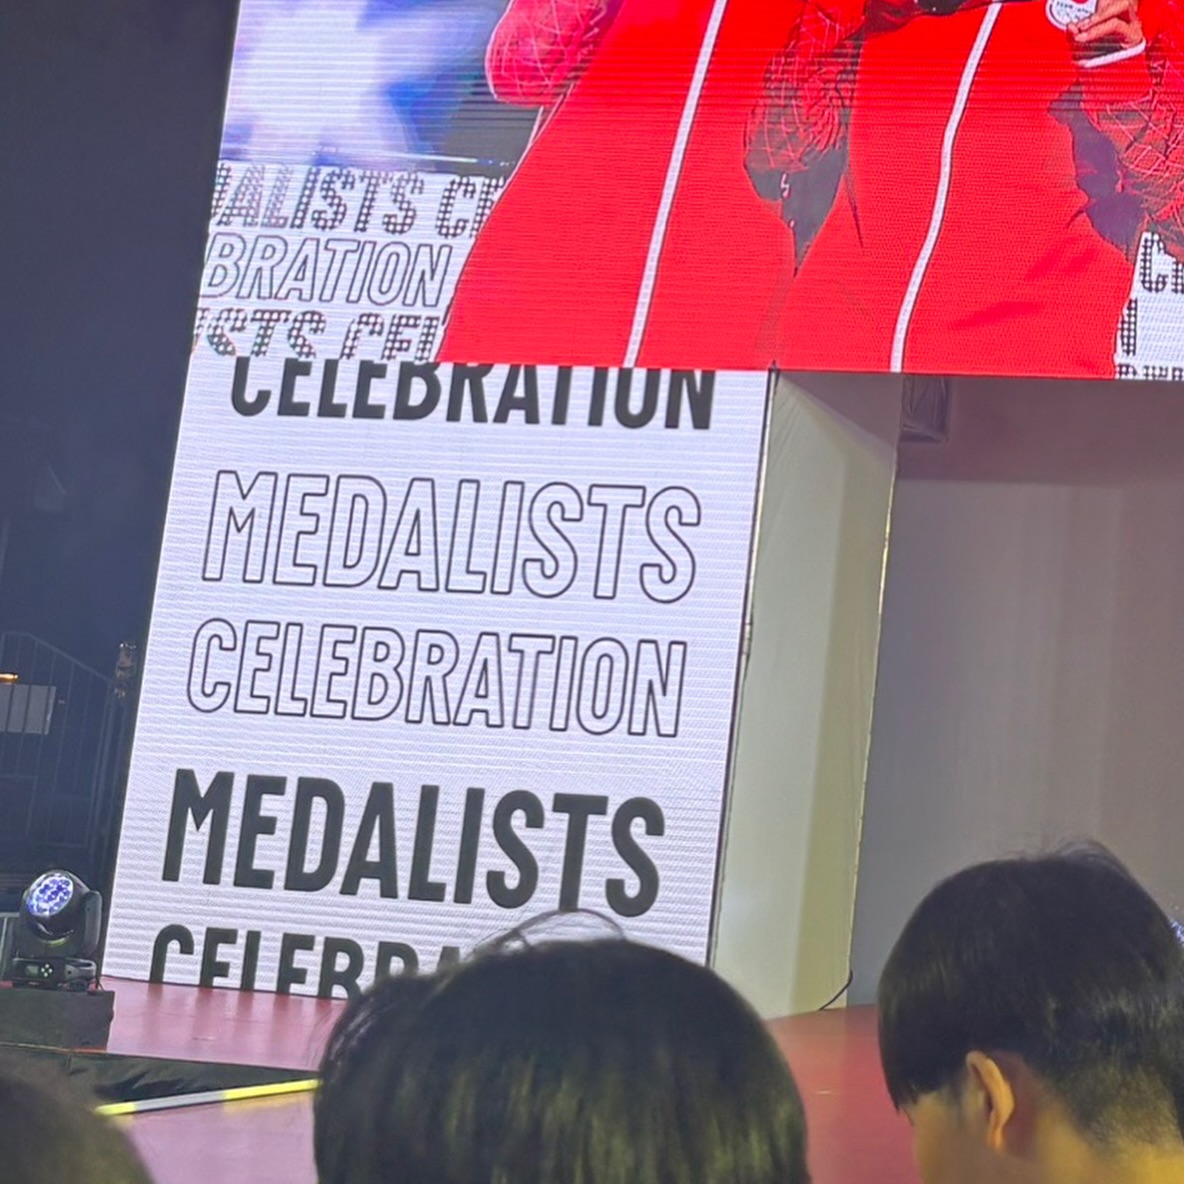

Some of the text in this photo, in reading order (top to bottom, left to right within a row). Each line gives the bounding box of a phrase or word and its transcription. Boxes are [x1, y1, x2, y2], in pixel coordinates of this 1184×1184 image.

[230, 357, 714, 430] CELEBRATION
[201, 469, 701, 604] MEDALISTS
[186, 617, 687, 738] CELEBRATION
[161, 767, 666, 918] MEDALISTS
